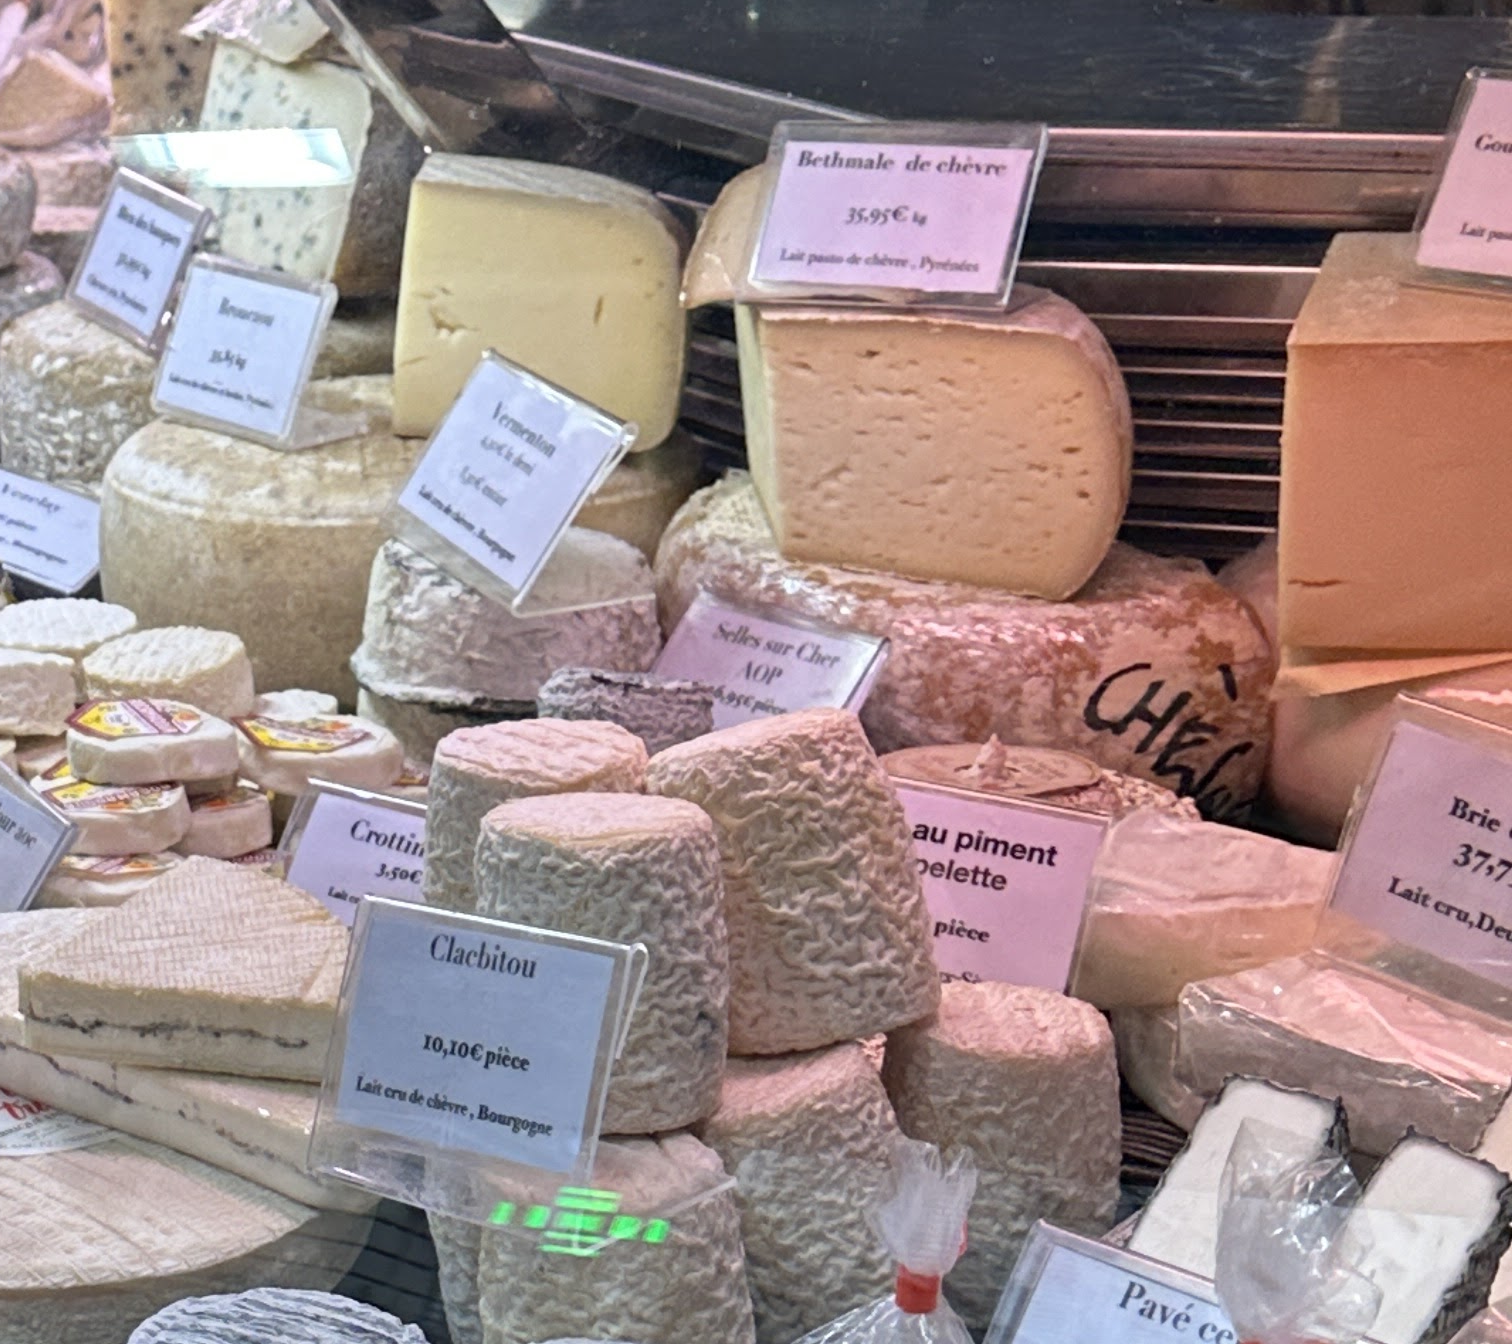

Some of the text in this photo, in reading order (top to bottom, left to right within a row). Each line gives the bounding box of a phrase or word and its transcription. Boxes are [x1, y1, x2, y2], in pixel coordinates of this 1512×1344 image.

[797, 150, 1008, 177] Bethmale de chèvre
[779, 248, 805, 263] Lait
[846, 253, 862, 265] de
[864, 253, 909, 268] chèvre
[492, 401, 557, 459] Vermenton
[712, 622, 841, 668] Selles sur Cher
[742, 660, 784, 685] AOP
[1448, 796, 1501, 833] Brie
[350, 818, 426, 857] Crottin
[912, 823, 1059, 867] au piment
[375, 863, 424, 885] 3,50€
[1453, 843, 1512, 888] 37,7
[1388, 876, 1431, 908] Lait
[933, 919, 991, 944] pièce
[430, 934, 538, 979] Clacbitou
[422, 1033, 531, 1072] 10,10€ pièce
[356, 1076, 553, 1137] Lait cru de chèvre Bourgogne
[1116, 1280, 1192, 1331] Pavé
